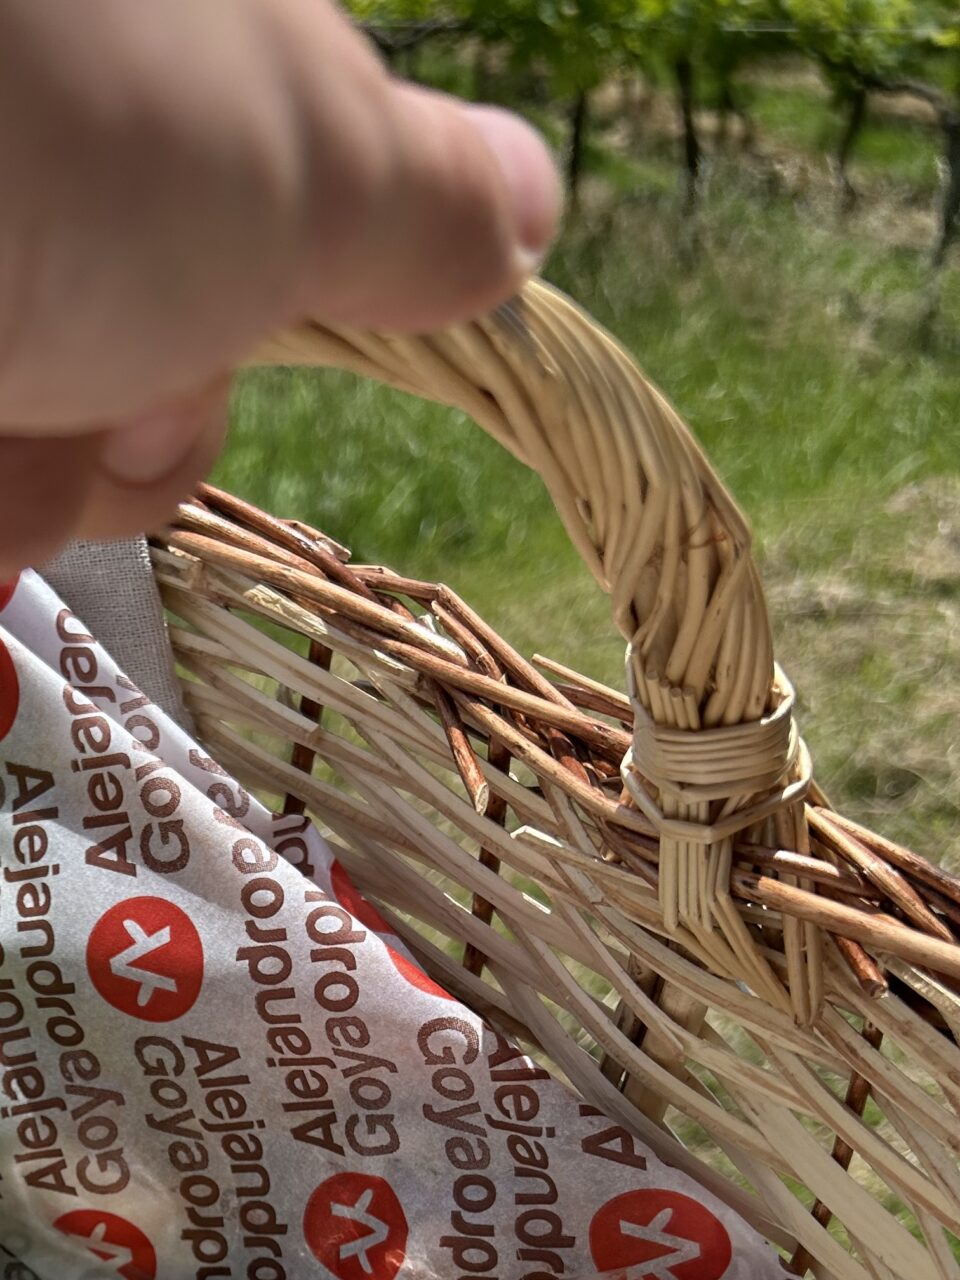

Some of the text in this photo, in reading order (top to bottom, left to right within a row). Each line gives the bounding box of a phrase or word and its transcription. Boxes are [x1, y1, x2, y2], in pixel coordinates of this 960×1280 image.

[3, 761, 85, 1047] Alejandro
[236, 877, 346, 1157] Alejandro
[326, 1016, 401, 1157] Goya
[59, 1049, 132, 1196] Goya
[134, 1035, 210, 1173] Goya
[416, 1016, 491, 1171] Goya
